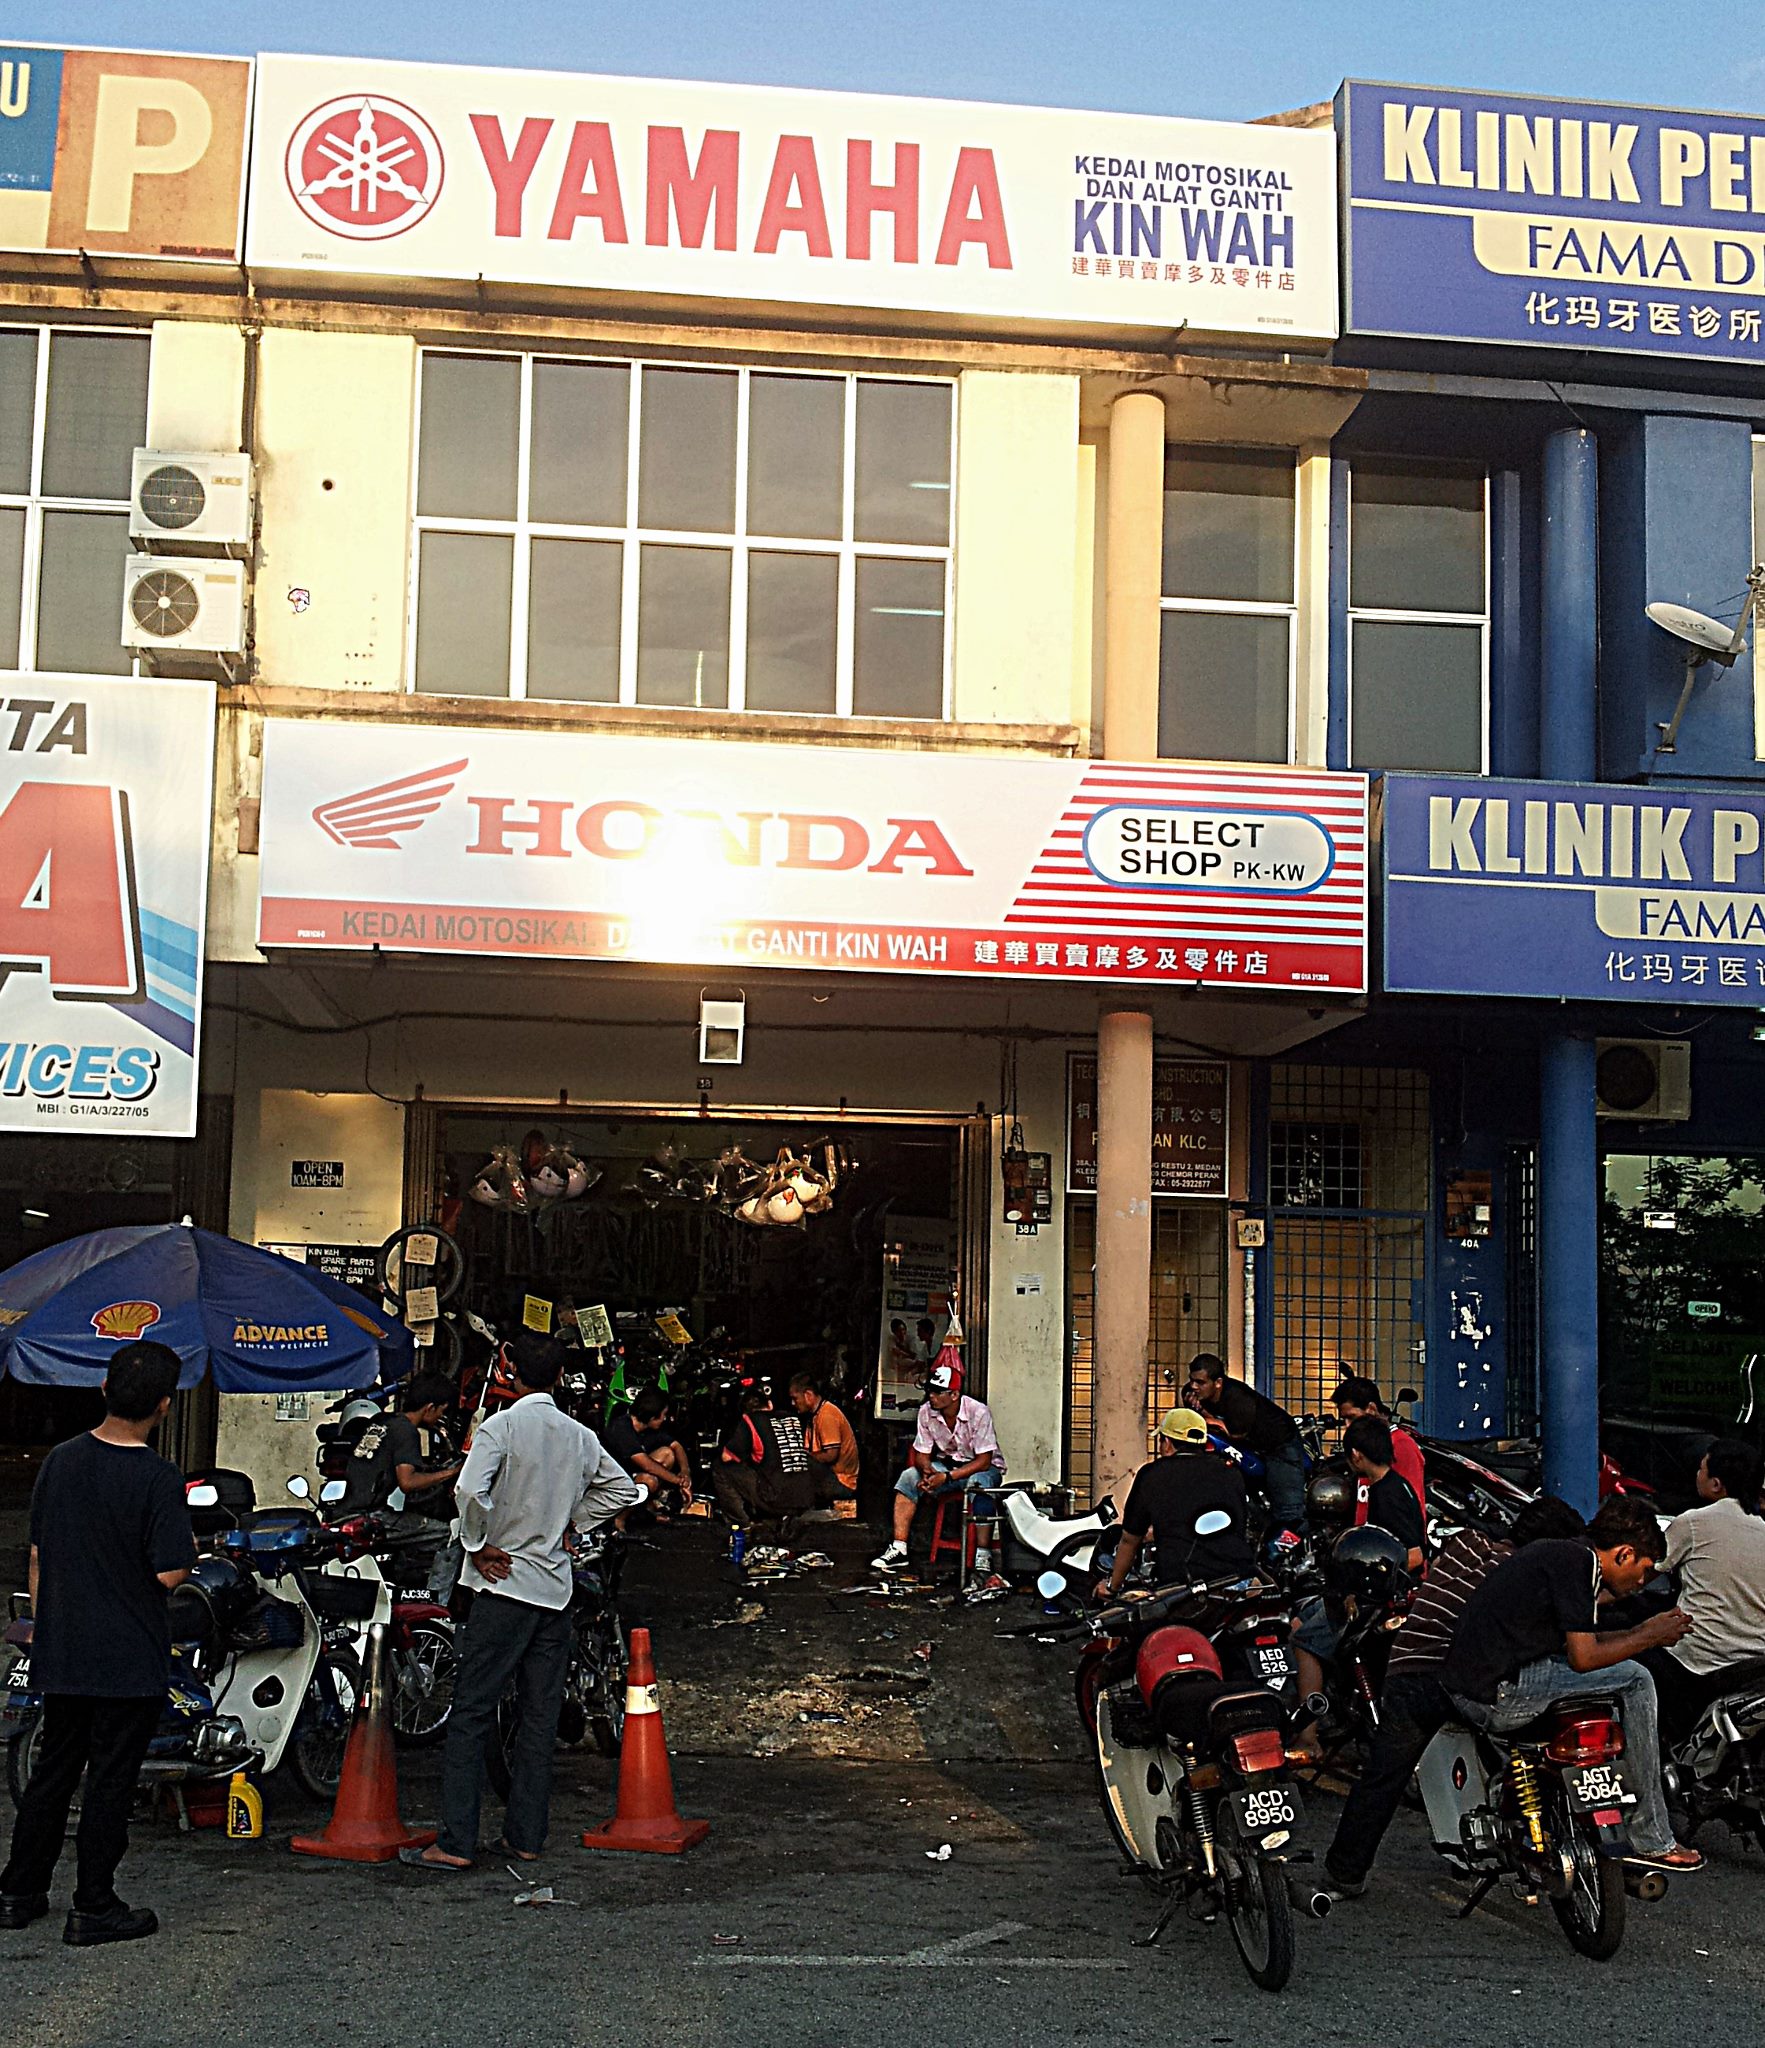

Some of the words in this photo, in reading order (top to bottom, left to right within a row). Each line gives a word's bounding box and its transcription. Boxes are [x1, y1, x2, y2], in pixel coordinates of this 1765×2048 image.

[86, 74, 212, 232] P
[1384, 103, 1640, 203] KLINIK
[1075, 156, 1145, 179] KEDAI
[1155, 162, 1293, 190] MOTOSIKAL
[469, 114, 1013, 269] YAMAHA
[1087, 179, 1133, 199] DAN
[1143, 183, 1202, 204] ALAT
[1210, 188, 1282, 211] GANTI
[1074, 199, 1161, 258] KIN
[1180, 208, 1293, 268] WAH
[1528, 224, 1692, 281] FAMA
[1713, 240, 1765, 288] D
[1072, 257, 1295, 291] 建華買賣摩多及零件店
[1525, 292, 1762, 343] 化玛牙医诊所
[0, 697, 88, 755] TA
[466, 796, 974, 877] HONDA
[1120, 817, 1265, 849] SELECT
[1429, 796, 1692, 882] KLINIK
[1713, 809, 1765, 884] P
[1119, 849, 1222, 877] SHOP
[1233, 861, 1305, 882] PK-KW
[1639, 898, 1765, 940] FAMA
[343, 911, 425, 940] KEDAI
[436, 915, 597, 948] MOTOSIKAL
[746, 928, 828, 958] GANTI
[836, 932, 879, 960] KIN
[887, 935, 947, 963] WAH
[974, 940, 1269, 976] 建華買賣摩多及零件店
[37, 1104, 59, 1113] MBI
[70, 1104, 149, 1117] G1/A/3/227/05
[1179, 1134, 1207, 1150] KLC
[303, 1162, 333, 1174] OPEN
[1161, 1162, 1185, 1170] RESTU
[293, 1174, 343, 1186] 10AM-8PM
[308, 1247, 323, 1257] KIN
[324, 1248, 340, 1257] WAH
[1461, 1239, 1479, 1249] 40A
[321, 1256, 347, 1266] SPARE
[350, 1257, 375, 1267] PARTS
[347, 1266, 375, 1275] SABTU
[233, 1325, 328, 1342] ADVANCE
[14, 1658, 30, 1671] AA
[1259, 1648, 1284, 1662] AED
[1261, 1661, 1288, 1674] 526
[1582, 1766, 1611, 1786] AGT
[1248, 1789, 1284, 1810] ACD
[1577, 1781, 1623, 1802] 5084
[1244, 1805, 1295, 1827] 8950
